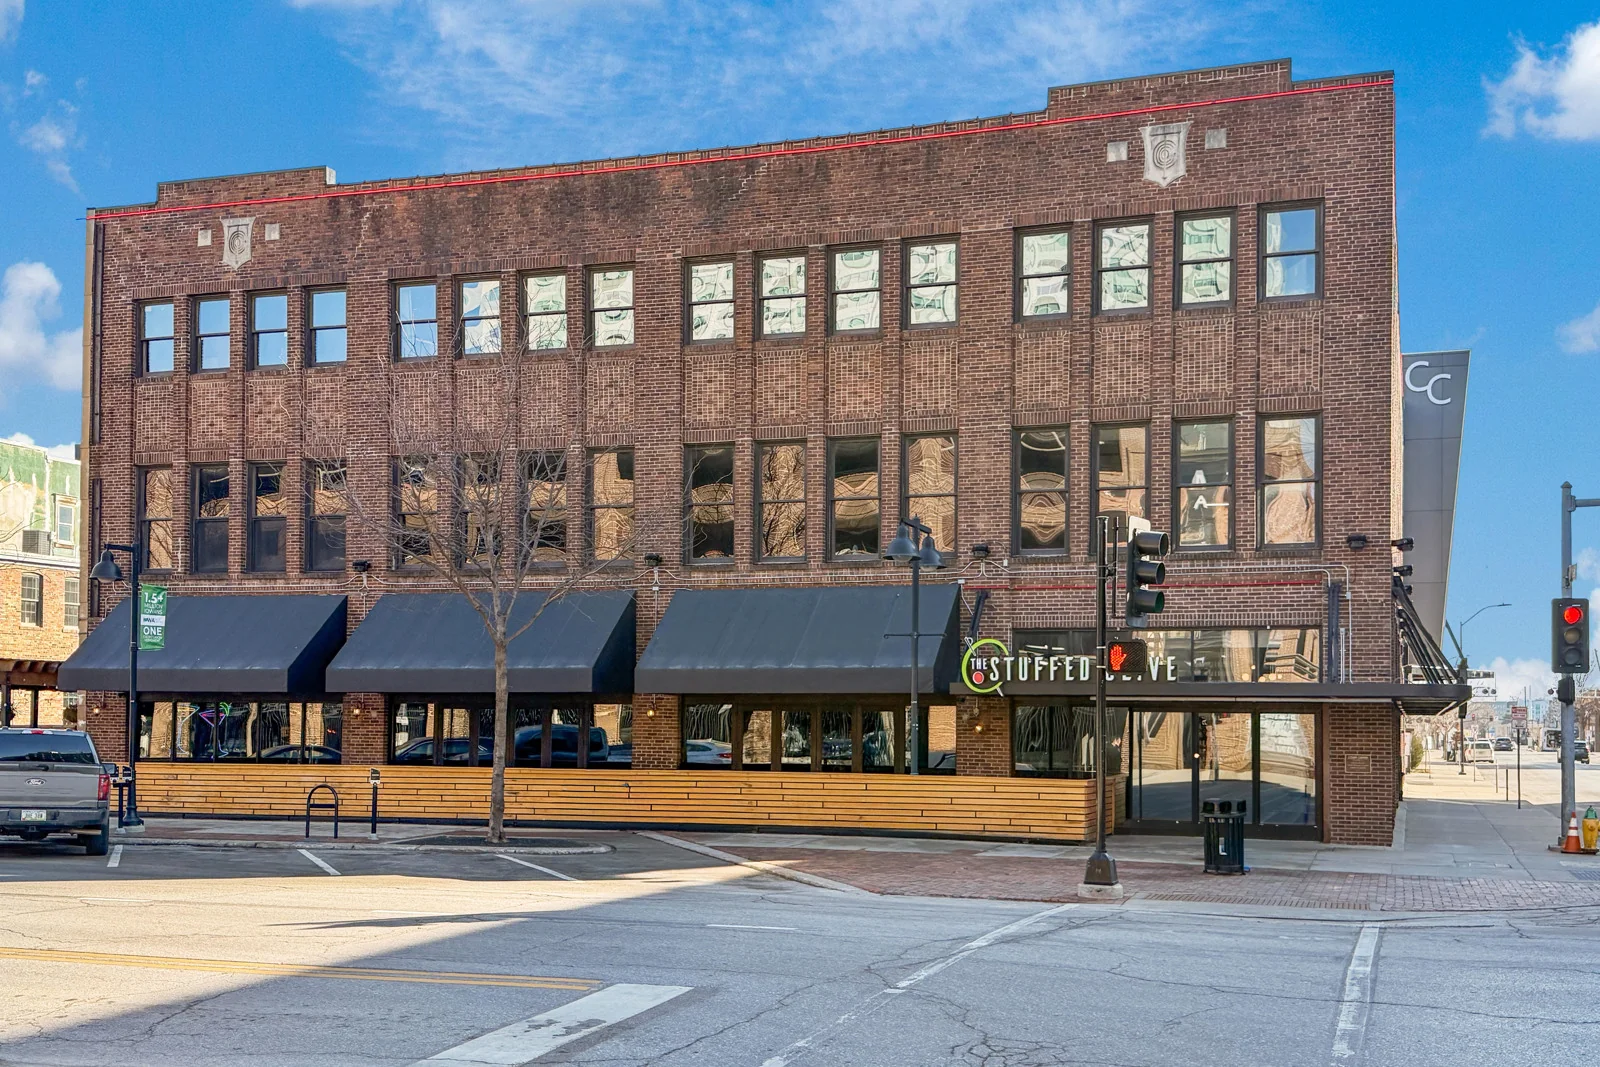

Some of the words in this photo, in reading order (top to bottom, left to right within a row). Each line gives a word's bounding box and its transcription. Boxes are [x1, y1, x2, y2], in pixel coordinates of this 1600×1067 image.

[144, 592, 164, 604] 1.5+
[143, 626, 162, 636] ONE
[970, 658, 988, 670] THE
[989, 656, 1090, 681] STUFFED
